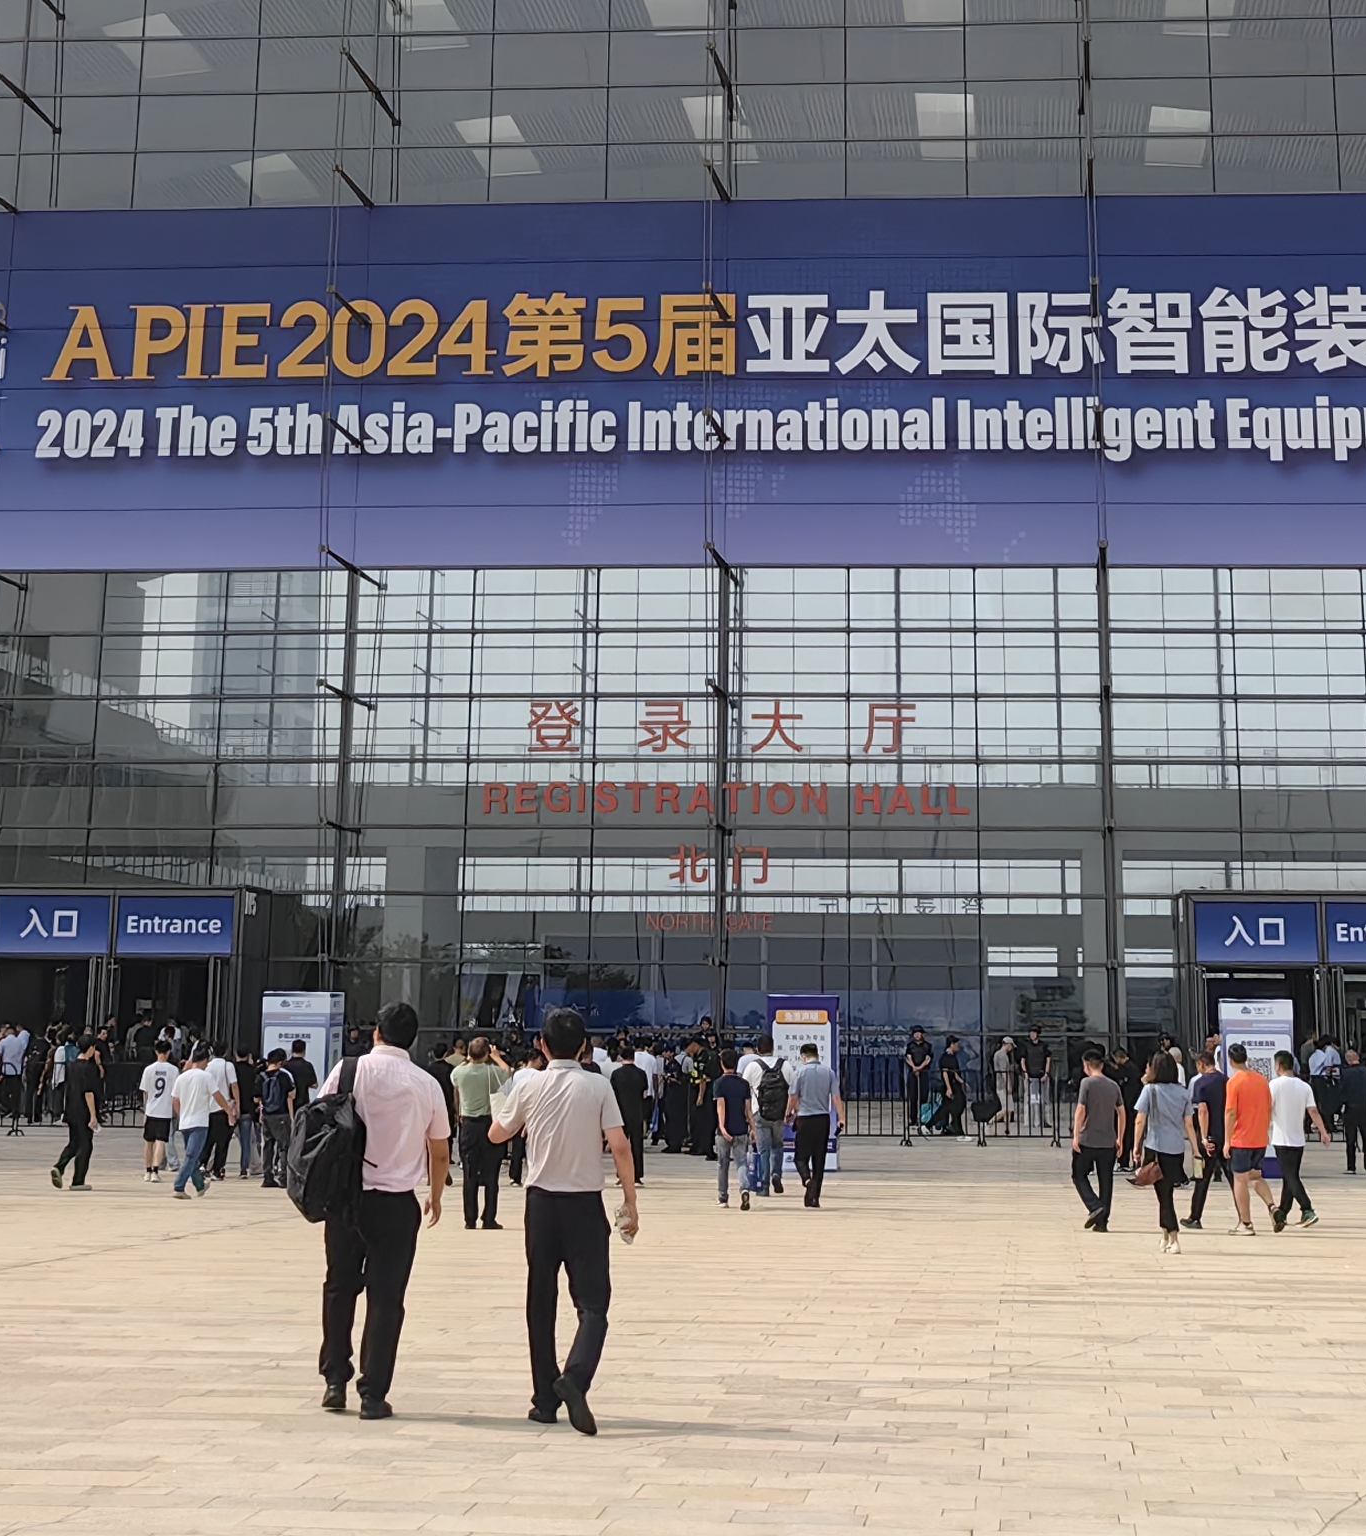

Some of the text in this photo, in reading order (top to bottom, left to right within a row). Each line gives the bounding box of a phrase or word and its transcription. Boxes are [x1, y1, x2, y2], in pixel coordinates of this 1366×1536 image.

[37, 408, 145, 459] 2024
[156, 406, 233, 456] The
[246, 403, 323, 455] 5th
[332, 400, 617, 454] Asia-Pacific
[627, 399, 950, 451] International
[956, 397, 1216, 462] Intelligent
[526, 700, 917, 753] 登录大厅
[483, 781, 971, 815] REGISTRATION HALL
[669, 844, 769, 885] 北门
[20, 909, 79, 940] 入口
[126, 914, 222, 935] Entrance
[645, 911, 715, 932] NORTH
[1224, 916, 1286, 947] 入口
[154, 1076, 167, 1099] 9
